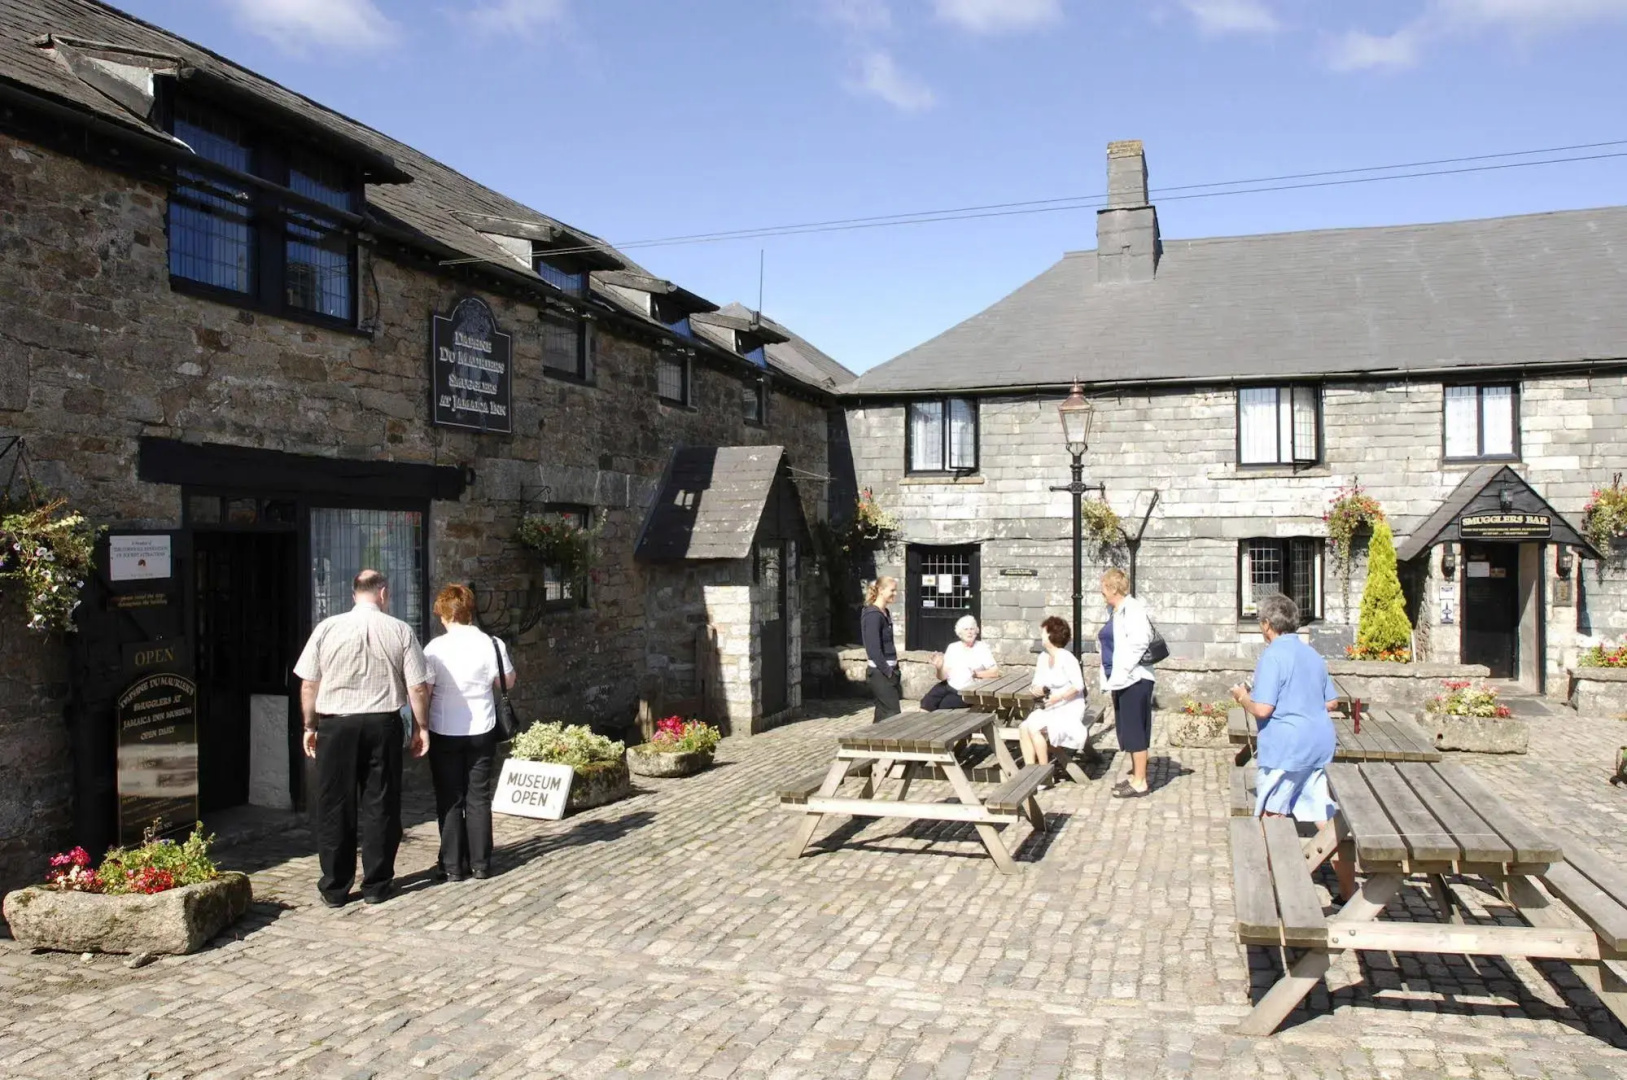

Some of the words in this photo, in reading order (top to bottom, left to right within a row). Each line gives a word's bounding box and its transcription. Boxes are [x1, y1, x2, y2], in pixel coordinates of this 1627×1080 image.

[1462, 515, 1524, 526] SMUGGLERS
[1525, 515, 1549, 526] BAR
[134, 648, 174, 667] OPEN
[173, 694, 182, 704] AT
[123, 715, 151, 730] JAMAICA
[140, 729, 157, 740] OPEN
[507, 771, 562, 791] MUSEUM
[511, 789, 549, 807] OPEN
